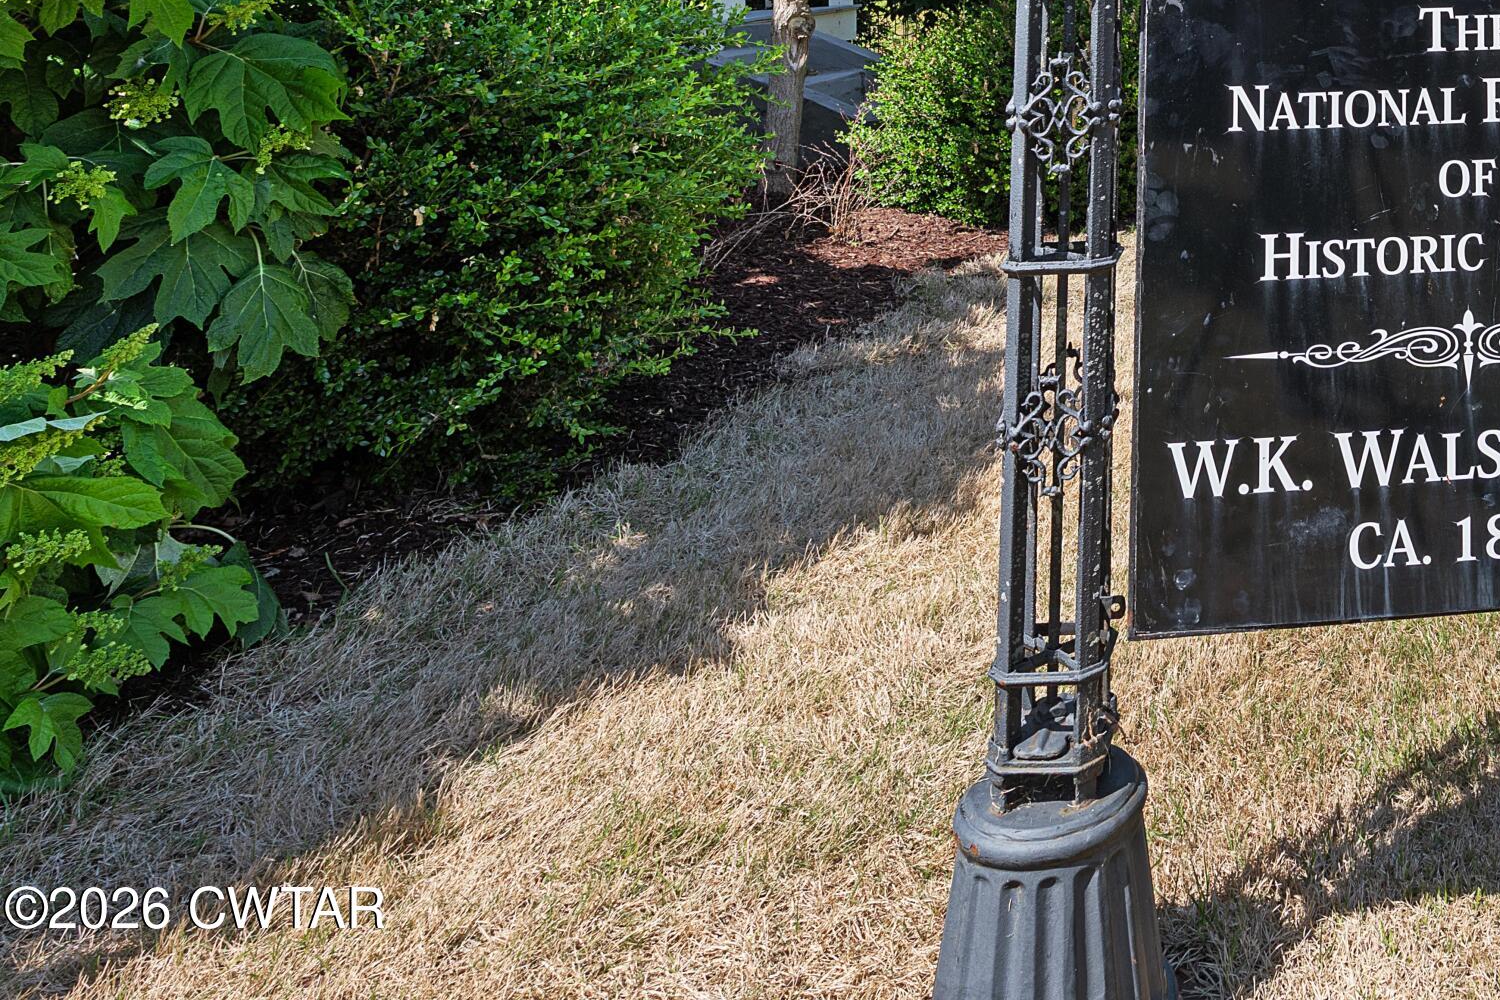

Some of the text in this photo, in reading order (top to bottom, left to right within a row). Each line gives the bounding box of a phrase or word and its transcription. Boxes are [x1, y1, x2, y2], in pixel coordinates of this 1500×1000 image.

[1228, 85, 1466, 131] NATIONAL
[1439, 159, 1497, 197] OF
[1260, 233, 1485, 281] HISTORIC
[1167, 436, 1312, 498] W.K.
[1350, 520, 1431, 569] CA.
